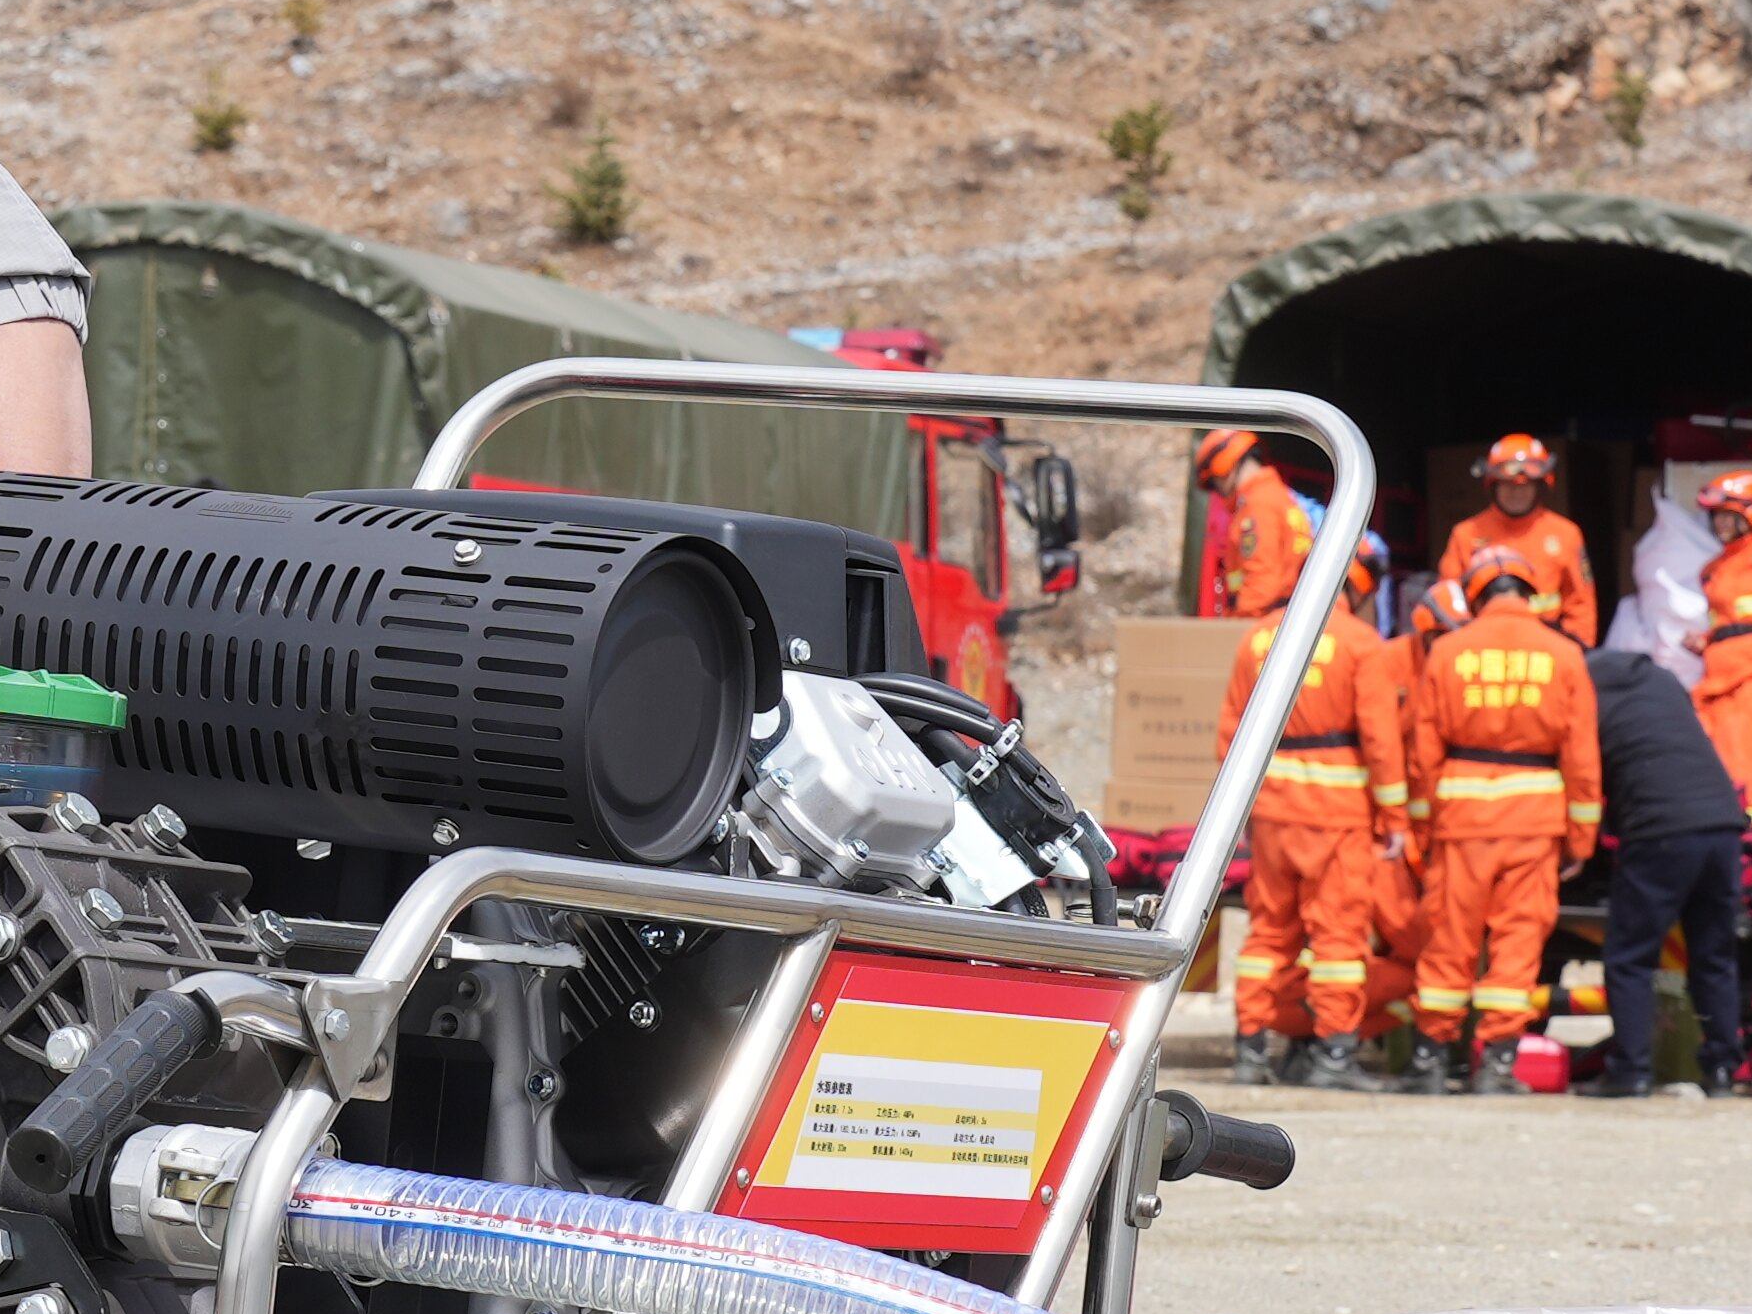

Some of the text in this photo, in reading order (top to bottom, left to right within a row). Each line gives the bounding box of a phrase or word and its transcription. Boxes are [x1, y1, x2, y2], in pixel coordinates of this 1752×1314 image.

[1454, 648, 1554, 685] 中国消防
[816, 1080, 854, 1095] 水泵参数表
